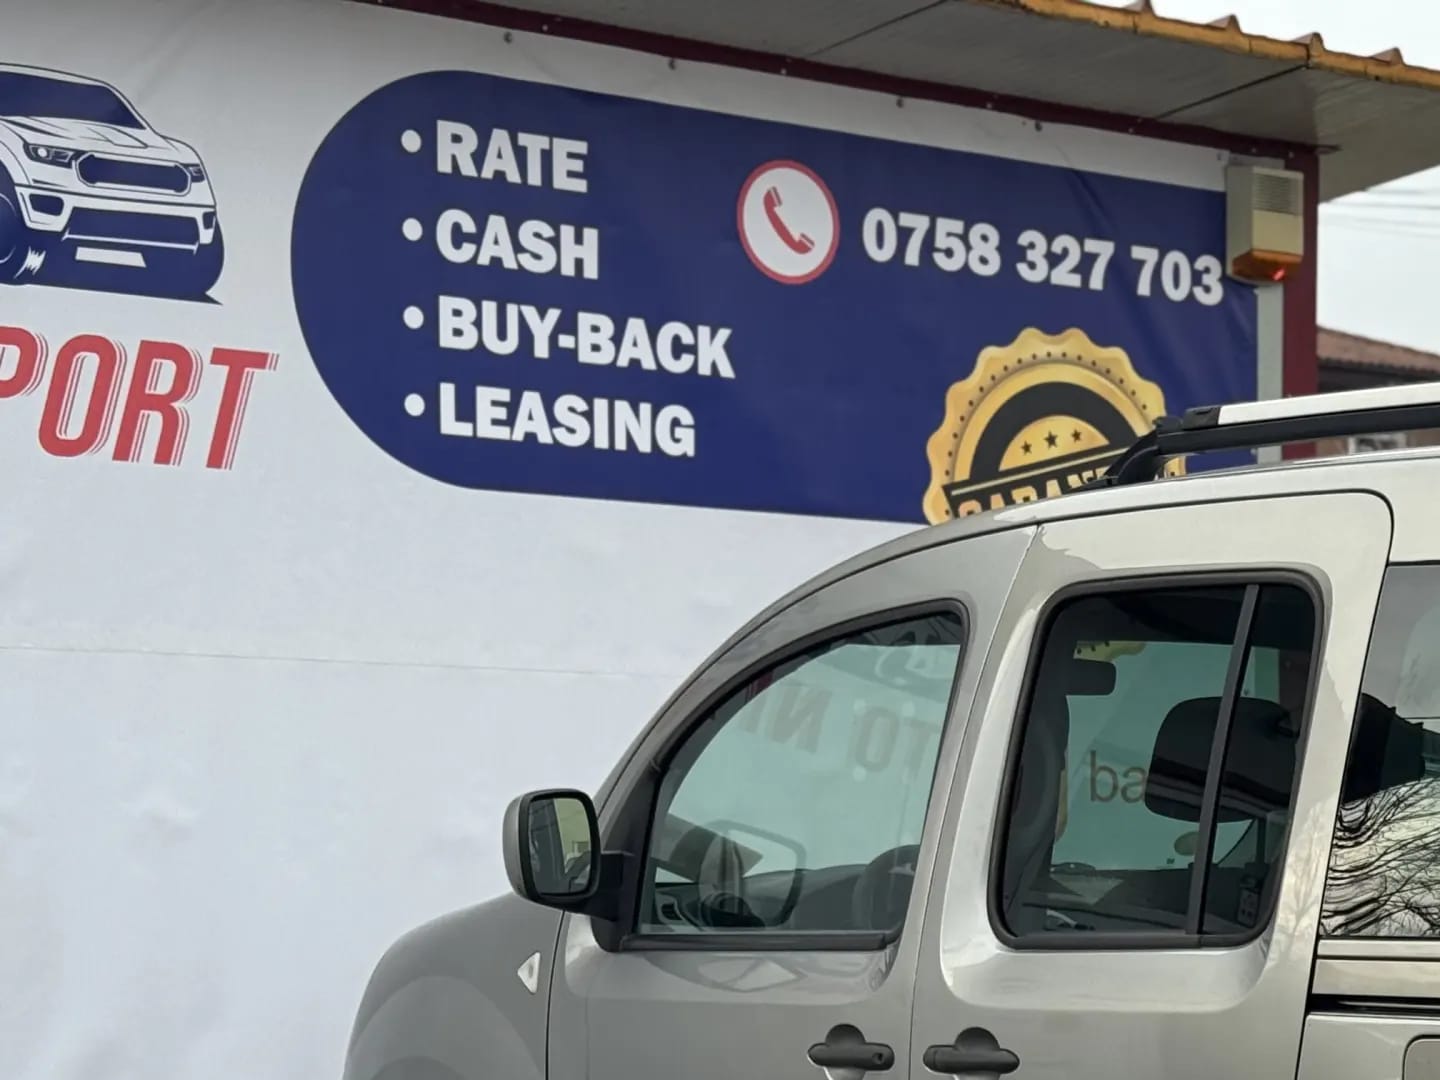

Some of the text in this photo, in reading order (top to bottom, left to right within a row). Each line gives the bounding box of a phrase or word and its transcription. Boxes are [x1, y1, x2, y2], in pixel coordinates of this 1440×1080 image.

[436, 119, 588, 193] RATE
[436, 208, 599, 280] CASH
[862, 207, 1224, 306] 0758 327 703
[438, 295, 736, 379] BUY-BACK
[440, 382, 695, 458] LEASING
